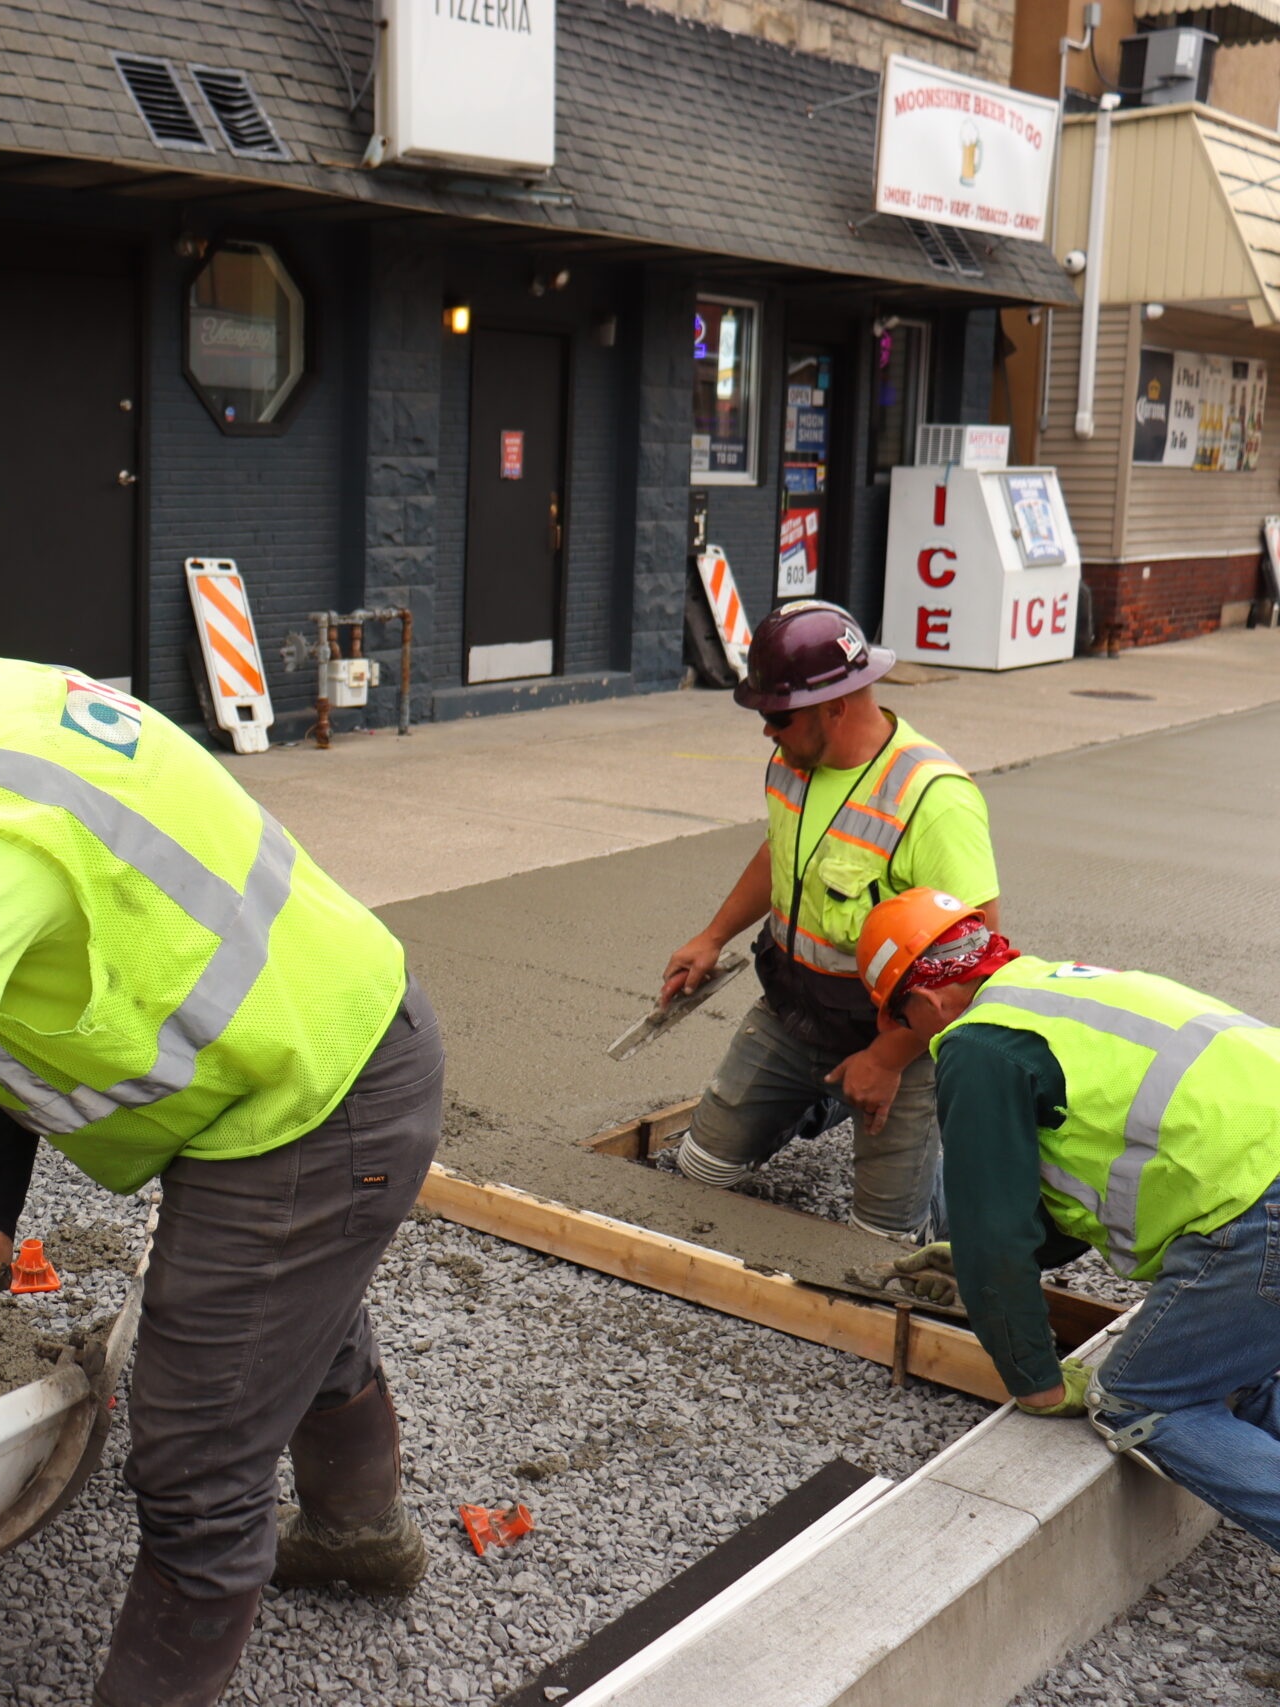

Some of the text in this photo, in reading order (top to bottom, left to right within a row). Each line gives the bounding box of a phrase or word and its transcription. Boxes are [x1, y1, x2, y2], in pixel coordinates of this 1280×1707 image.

[894, 88, 1042, 150] MOONSHINE BEER TO GO
[883, 185, 1041, 231] SMOKE LOTTO VAPE TOBACCO CANDY
[799, 428, 824, 443] SHINE
[786, 565, 805, 585] 603
[916, 482, 957, 651] ICE
[1010, 592, 1068, 640] ICE
[363, 1175, 385, 1184] ARIAT
